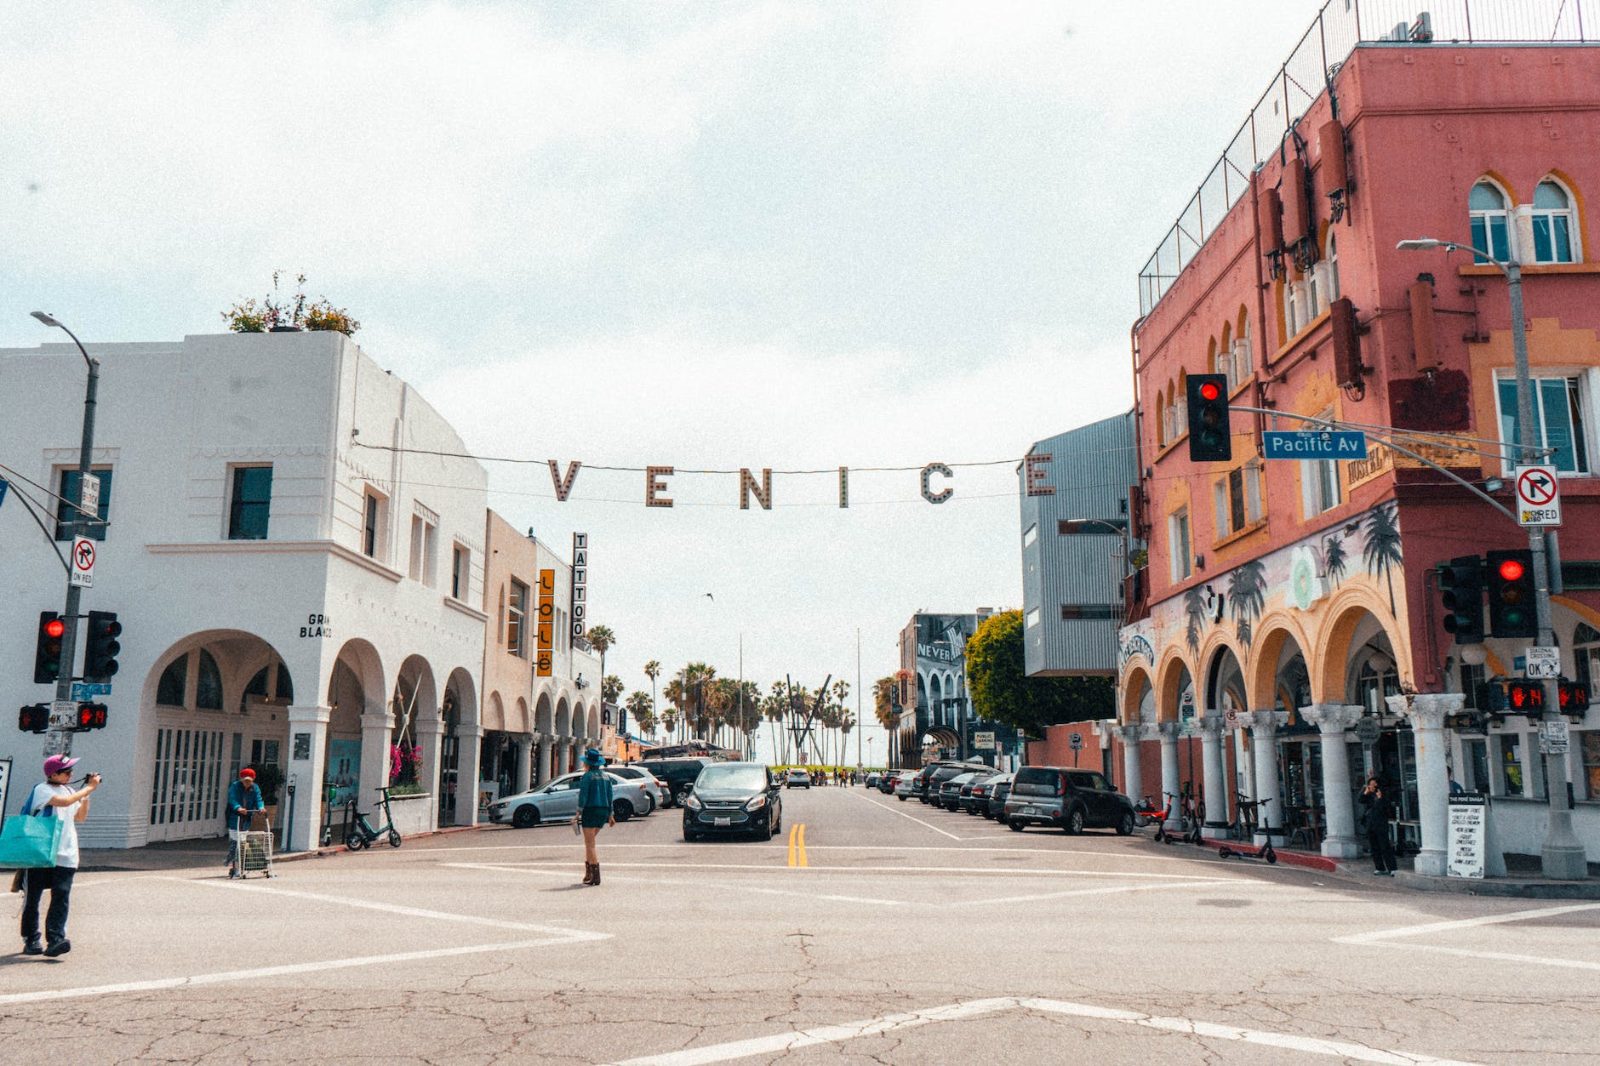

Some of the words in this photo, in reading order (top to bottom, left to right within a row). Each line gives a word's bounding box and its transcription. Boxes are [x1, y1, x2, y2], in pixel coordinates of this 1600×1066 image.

[1272, 437, 1332, 452] Pacific
[1338, 437, 1359, 452] Av
[548, 453, 1056, 510] VENICE
[73, 572, 81, 582] ON
[82, 573, 92, 584] RED
[574, 534, 585, 636] TATTOO
[917, 642, 950, 661] NEVER
[1529, 663, 1541, 675] OK
